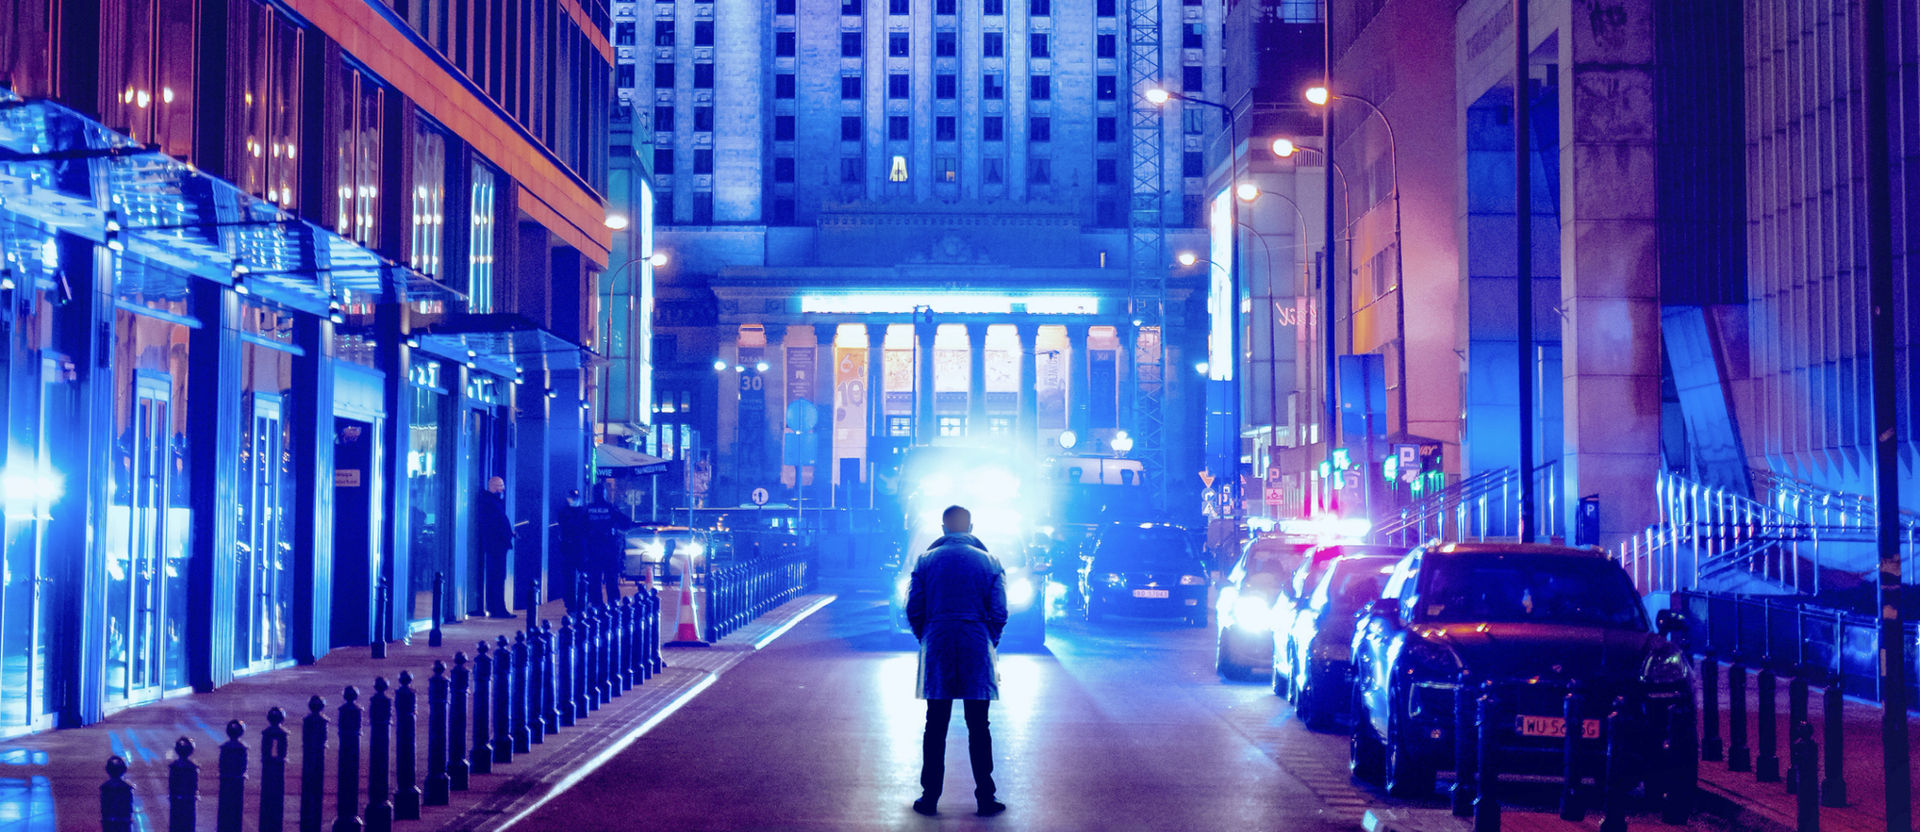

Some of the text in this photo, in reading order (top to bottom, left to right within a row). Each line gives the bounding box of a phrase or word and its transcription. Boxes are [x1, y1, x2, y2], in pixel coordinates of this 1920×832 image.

[742, 376, 762, 390] 30
[1400, 447, 1414, 467] P
[1269, 468, 1279, 482] P
[1587, 504, 1595, 516] P
[1527, 719, 1546, 734] WU
